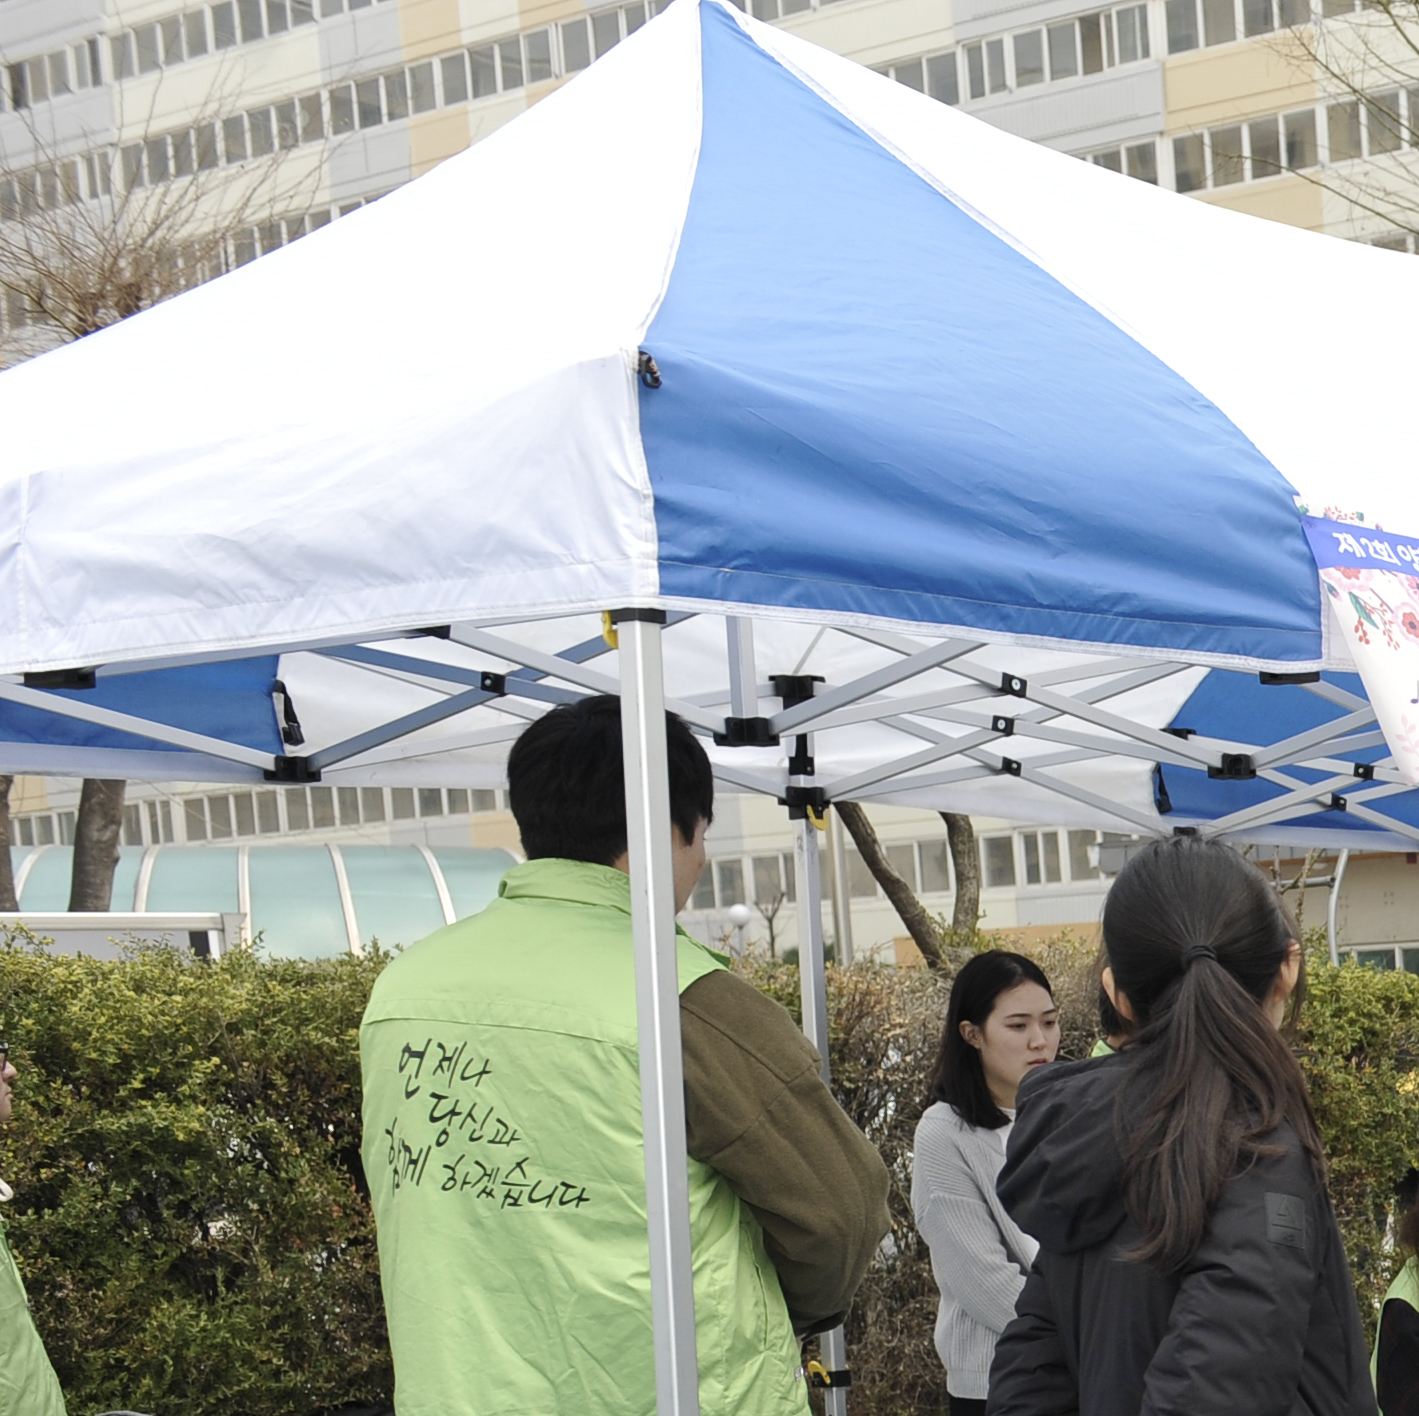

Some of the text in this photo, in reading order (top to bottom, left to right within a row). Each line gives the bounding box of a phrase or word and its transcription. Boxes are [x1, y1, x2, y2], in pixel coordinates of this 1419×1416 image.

[1332, 532, 1366, 558] 제
[1360, 538, 1401, 566] 2회
[399, 1038, 492, 1100] 언제나
[429, 1091, 521, 1148] 당신과
[385, 1117, 590, 1209] 함께 하겠습니다
